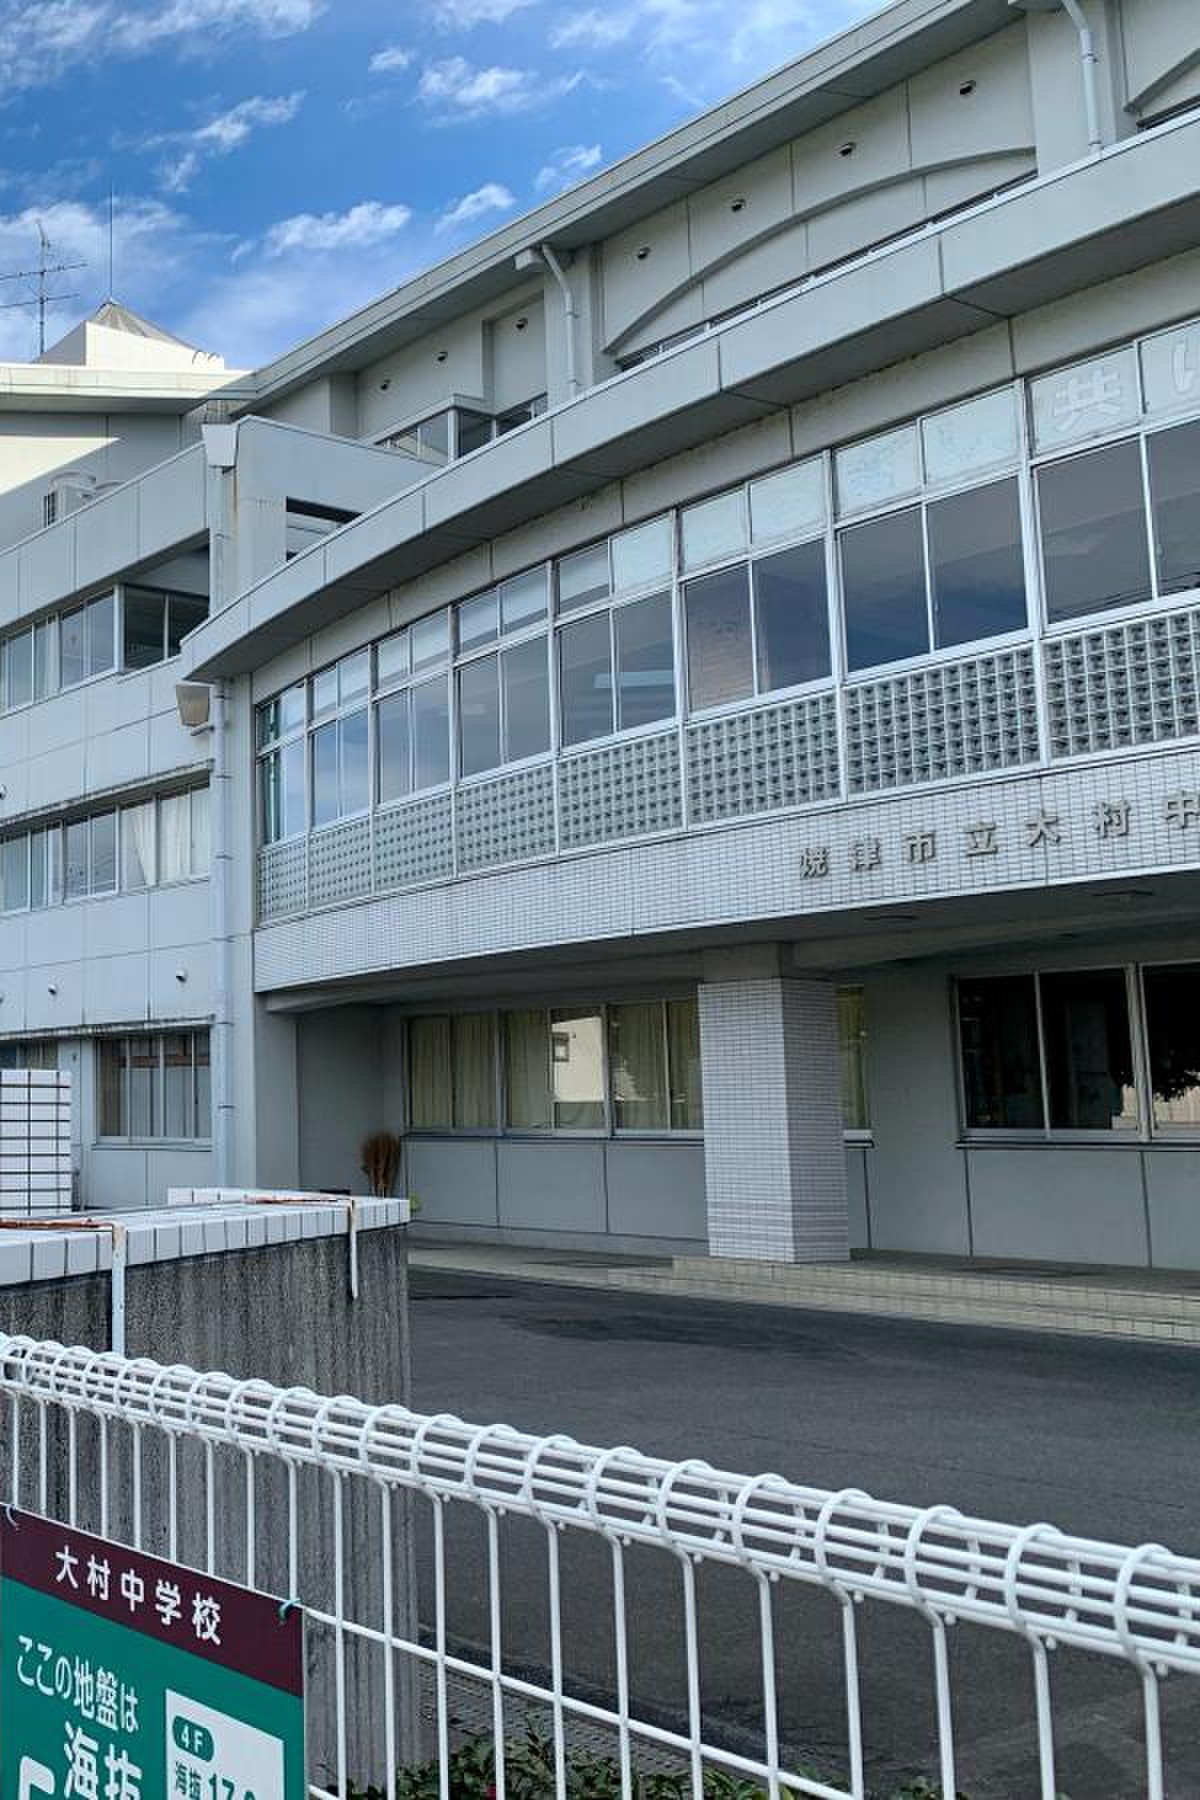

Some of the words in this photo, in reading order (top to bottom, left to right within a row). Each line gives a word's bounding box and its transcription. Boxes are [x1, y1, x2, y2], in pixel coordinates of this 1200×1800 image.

[54, 1545, 222, 1646] 大村中学校
[17, 1634, 140, 1733] ここの地盤は
[180, 1725, 204, 1754] 4F
